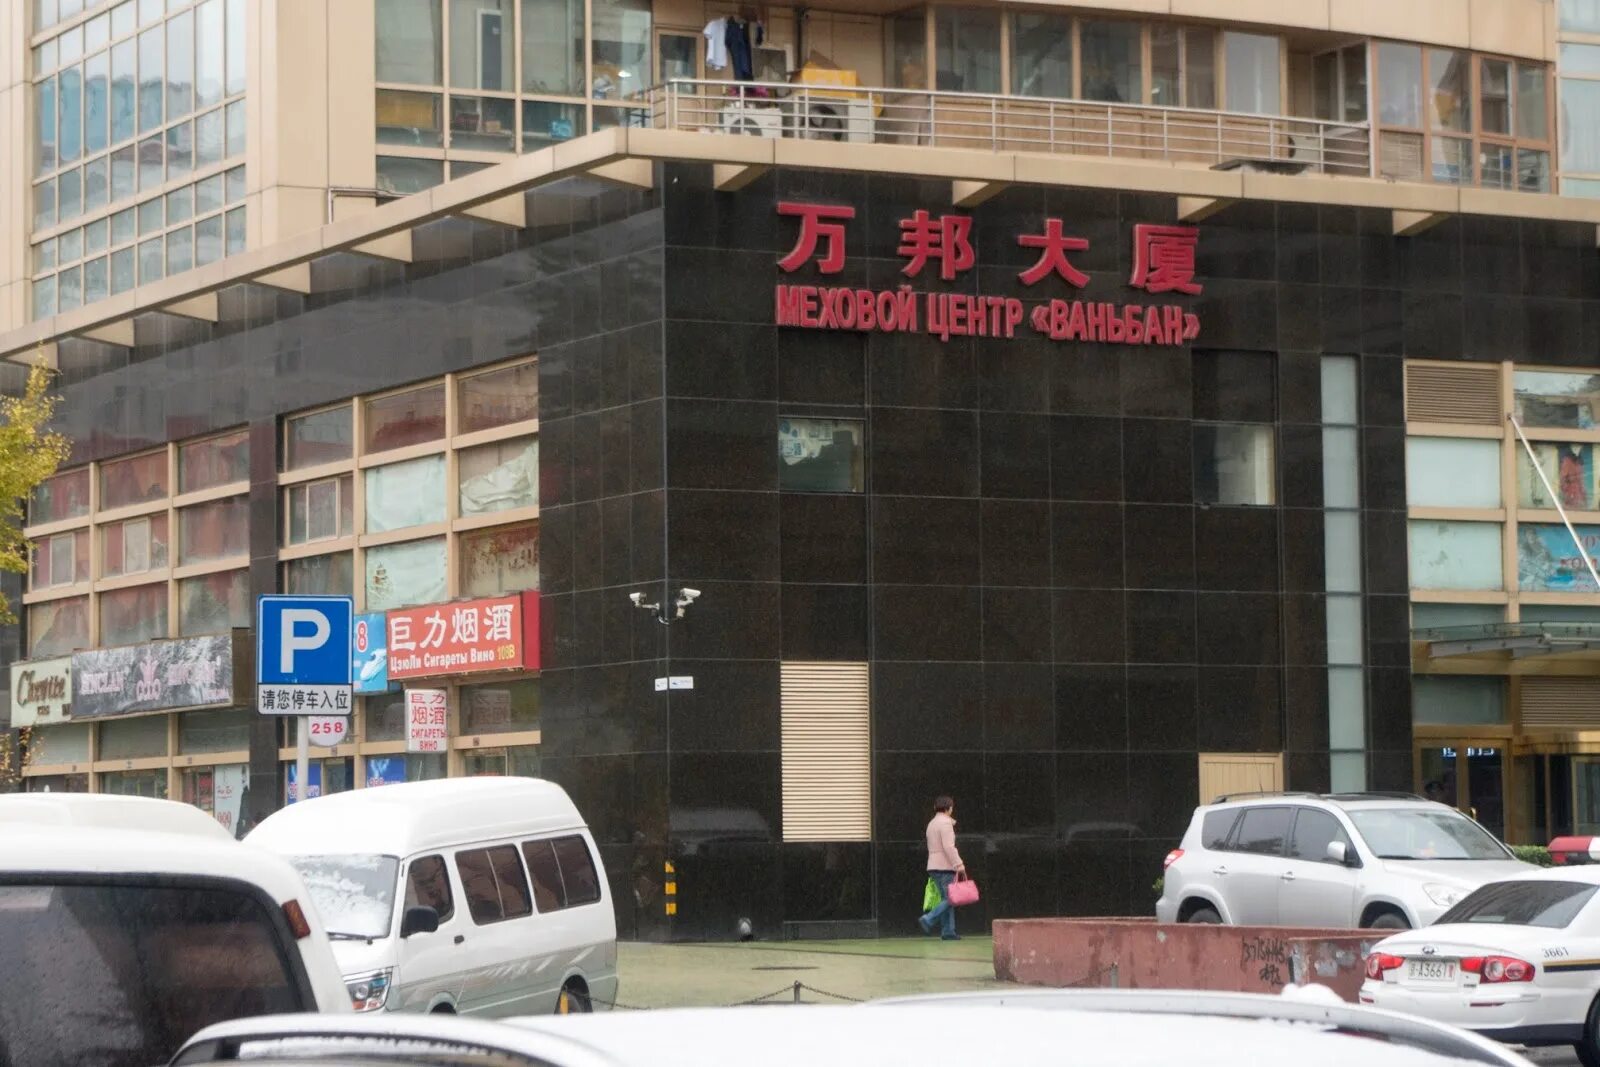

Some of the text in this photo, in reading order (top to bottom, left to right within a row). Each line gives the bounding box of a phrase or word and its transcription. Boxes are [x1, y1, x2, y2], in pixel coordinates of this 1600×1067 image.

[776, 202, 1203, 295] 万邦大厦
[775, 285, 917, 332] МЕХОВОЙ
[927, 293, 1023, 342] ЦЕНТР
[390, 604, 514, 651] 巨力烟酒
[280, 609, 331, 673] P
[424, 652, 468, 669] Сигареты
[470, 648, 495, 663] Вино
[262, 690, 349, 710] 请您停车入位
[411, 693, 445, 704] 巨力
[411, 706, 446, 725] 烟酒
[311, 722, 343, 735] 258
[411, 728, 447, 739] СИГАРЕТЫ
[420, 740, 438, 750] ВИНО
[1543, 947, 1569, 958] 3661
